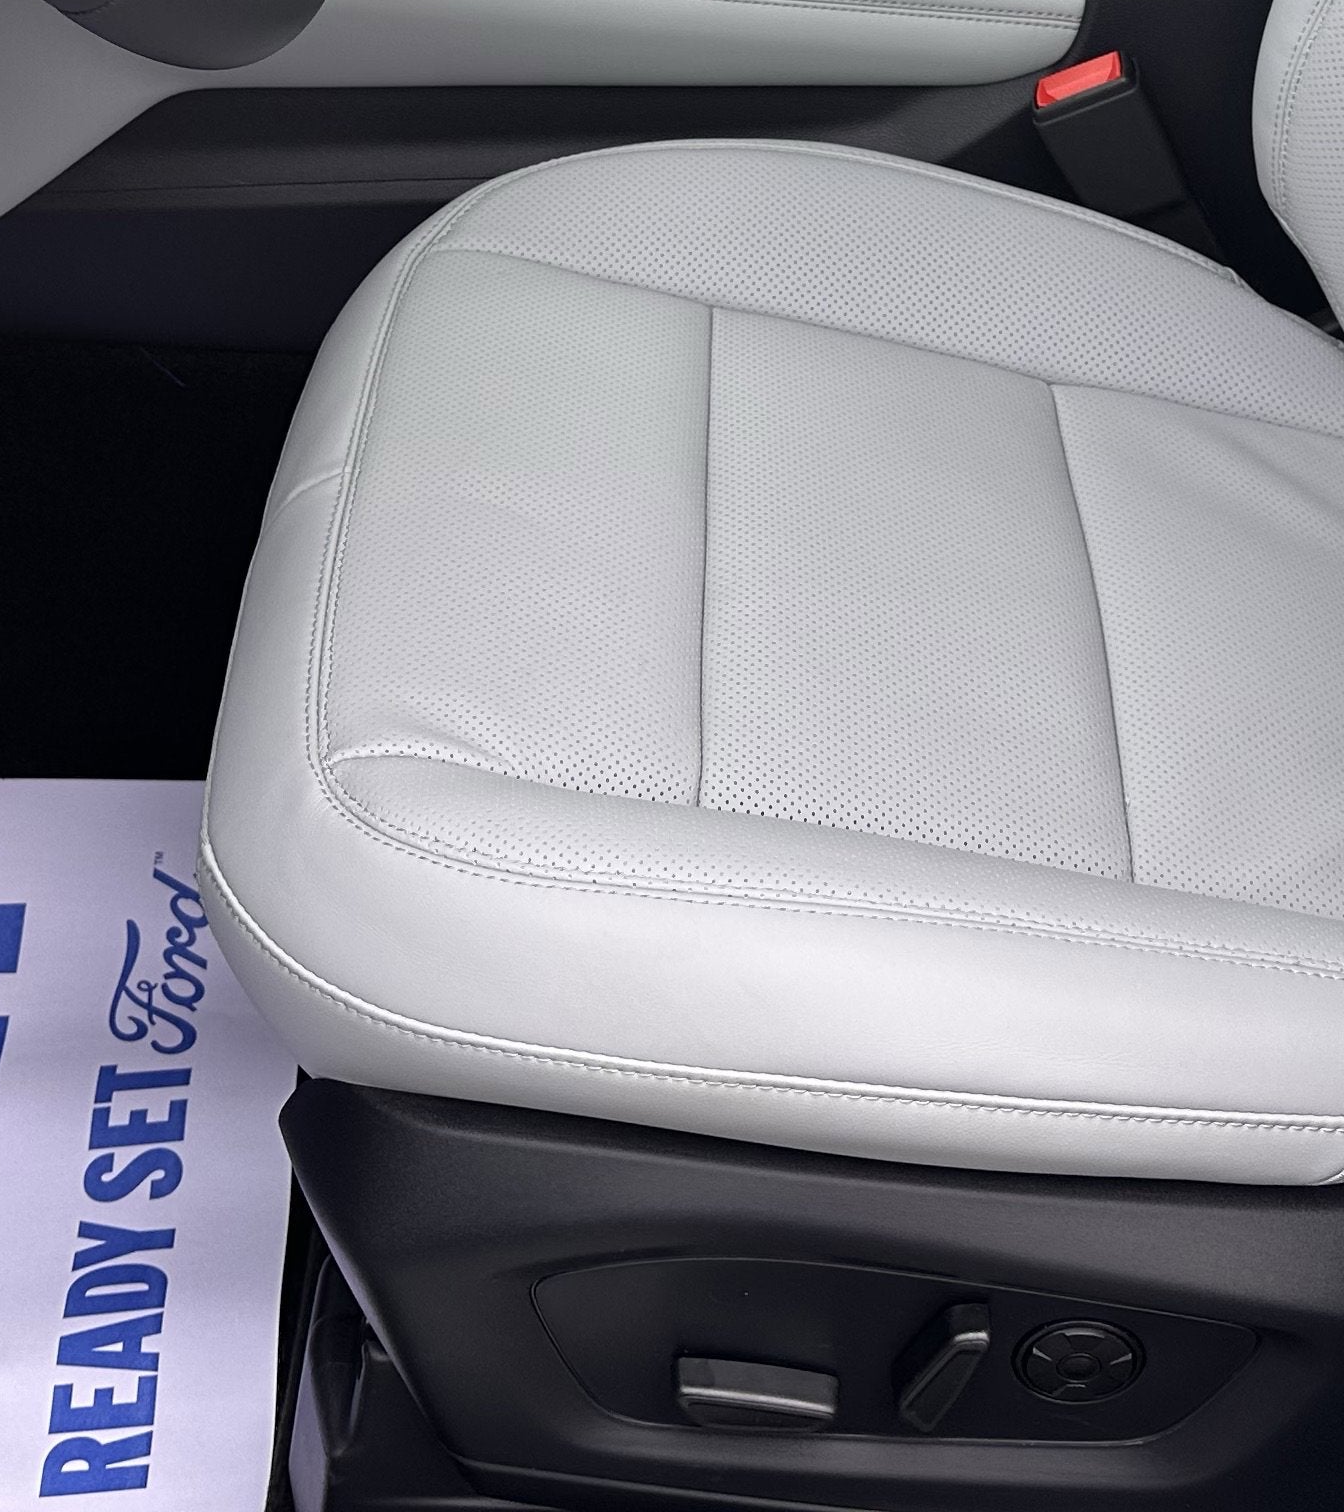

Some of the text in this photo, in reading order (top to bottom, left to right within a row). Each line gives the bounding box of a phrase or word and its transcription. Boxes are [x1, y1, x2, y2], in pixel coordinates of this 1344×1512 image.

[109, 867, 210, 1055] Ford
[83, 1064, 193, 1203] SET
[38, 1220, 177, 1498] READY
